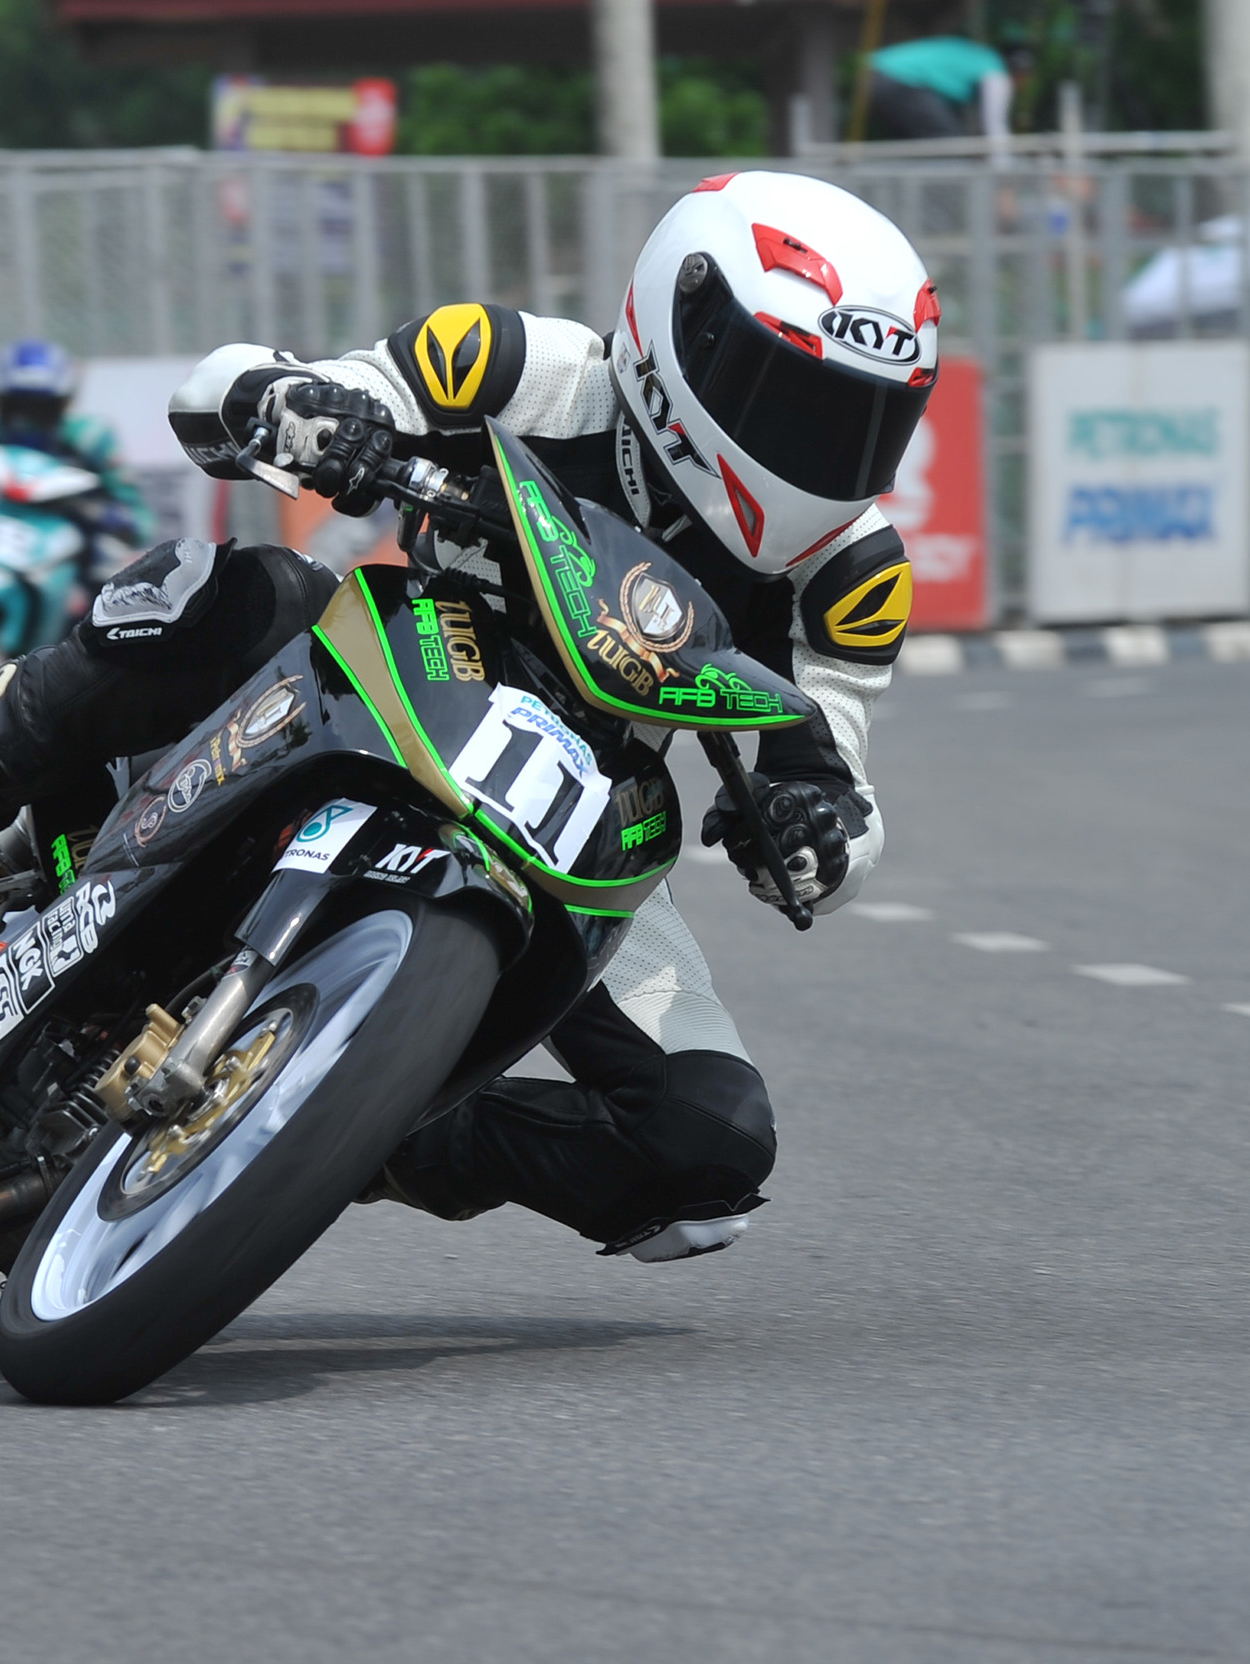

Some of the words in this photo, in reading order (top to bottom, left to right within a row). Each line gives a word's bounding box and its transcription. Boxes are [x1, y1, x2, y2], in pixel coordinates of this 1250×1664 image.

[835, 312, 915, 356] KYT
[634, 342, 720, 478] KYT
[621, 421, 640, 495] AICHI
[550, 545, 598, 638] TECH
[118, 627, 162, 639] TAICHI
[419, 634, 450, 681] TECH
[720, 688, 784, 713] TECH
[510, 706, 587, 779] PRIMAX
[465, 719, 585, 866] 11
[284, 848, 331, 861] TRONAS
[375, 843, 451, 874] KYT
[13, 931, 44, 991] NGK
